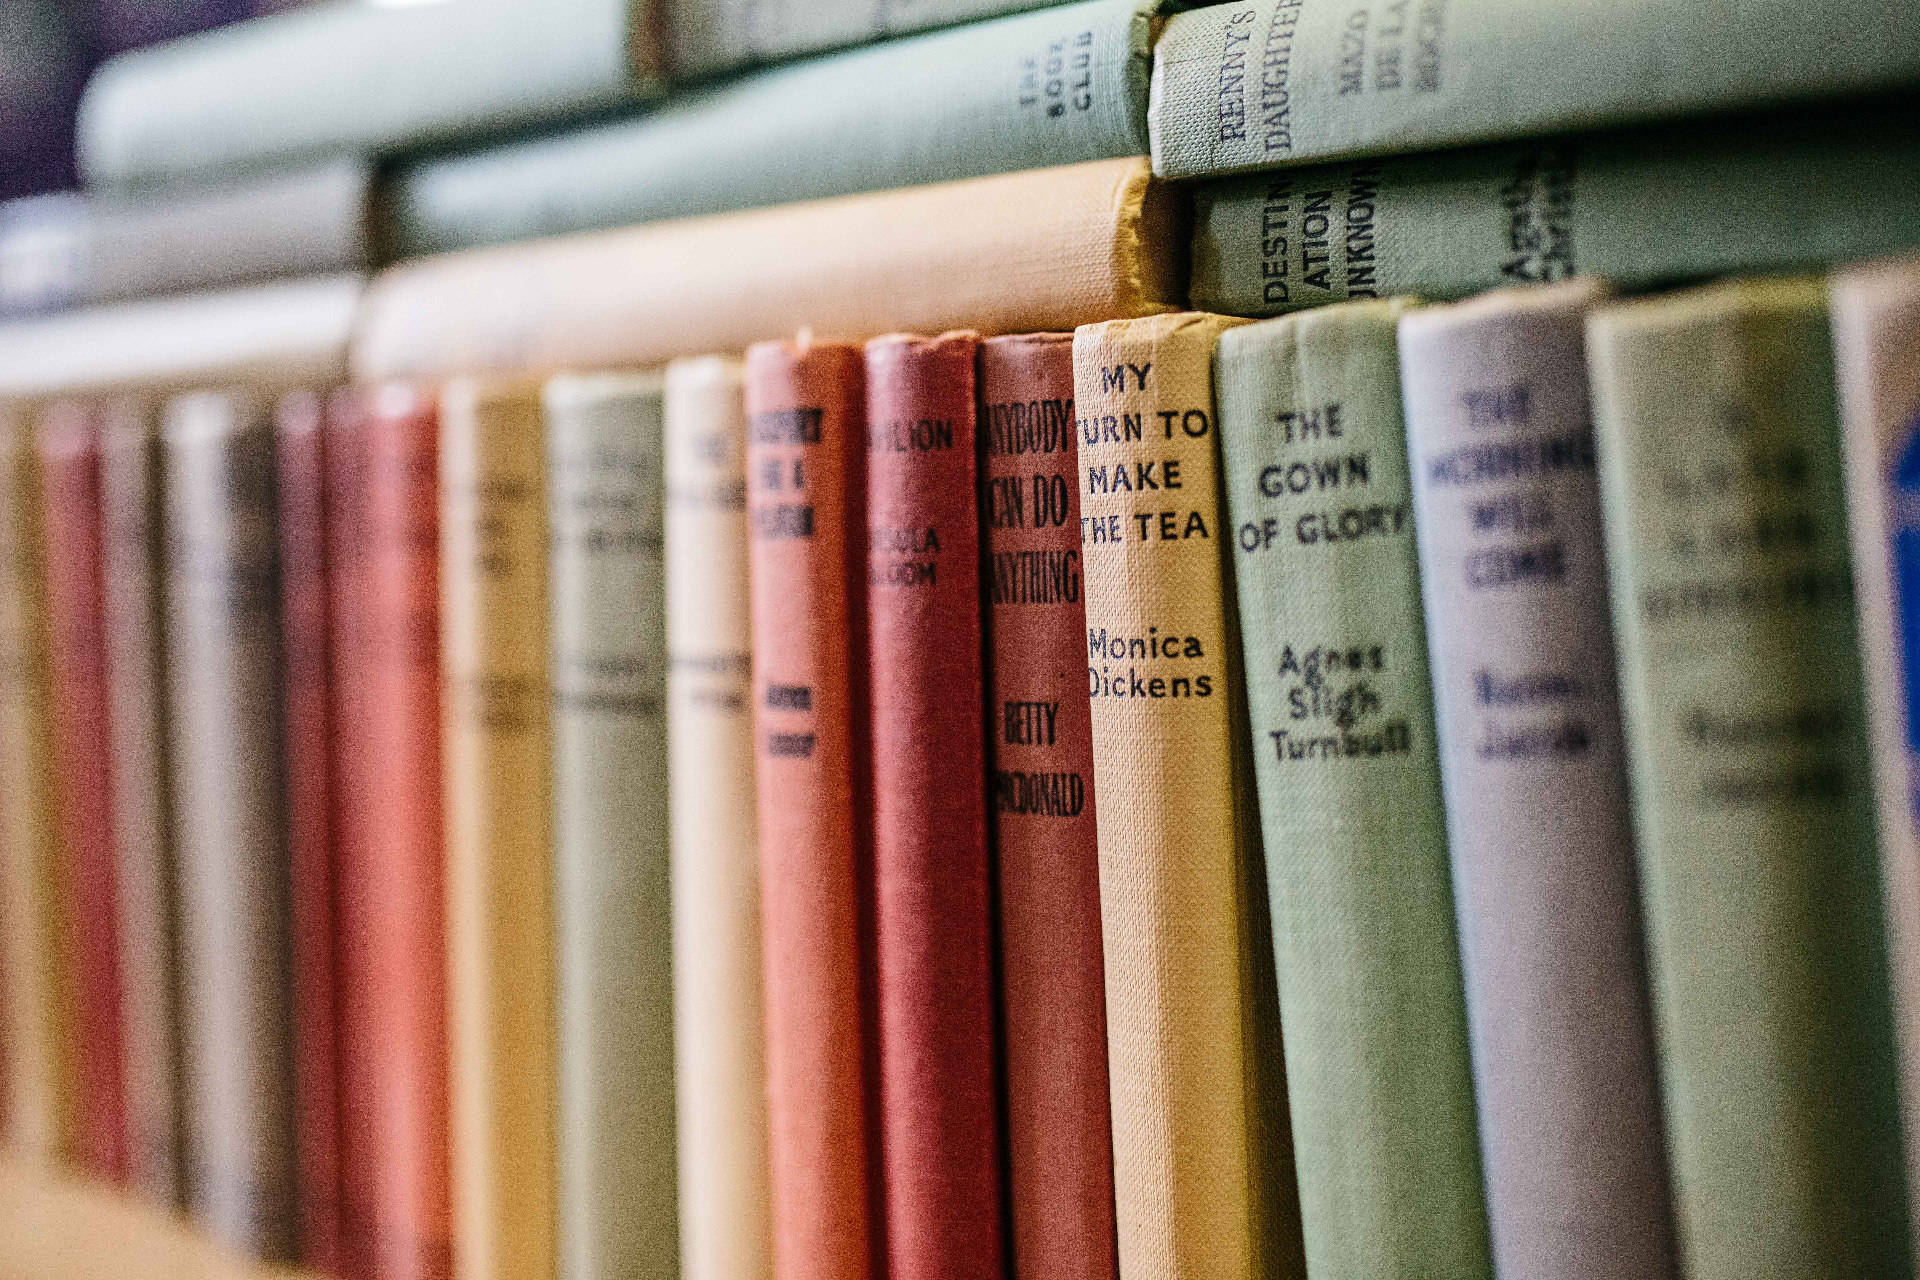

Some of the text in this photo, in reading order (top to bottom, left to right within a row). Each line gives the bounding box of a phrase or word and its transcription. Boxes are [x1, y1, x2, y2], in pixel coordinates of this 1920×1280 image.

[1073, 31, 1092, 111] CLUB
[1340, 9, 1369, 96] MAZO
[1220, 10, 1257, 143] RENNY'S
[1302, 190, 1333, 291] ATION
[1101, 363, 1154, 394] MY
[987, 398, 1075, 457] NYBODY
[1157, 409, 1209, 439] TO
[1276, 401, 1343, 444] THE
[1089, 460, 1183, 495] MAKE
[1258, 451, 1371, 499] GOWN
[1032, 473, 1070, 529] DO
[1081, 511, 1210, 545] THE TEA
[1239, 503, 1413, 553] OF GLORY
[991, 549, 1080, 605] NYTHING
[1089, 626, 1204, 660] Monica
[1277, 642, 1386, 691] Agnes
[1089, 667, 1214, 699] Dickens
[1004, 701, 1059, 747] BETTY
[1269, 719, 1412, 763] Turnbull
[997, 771, 1085, 818] DONALD
